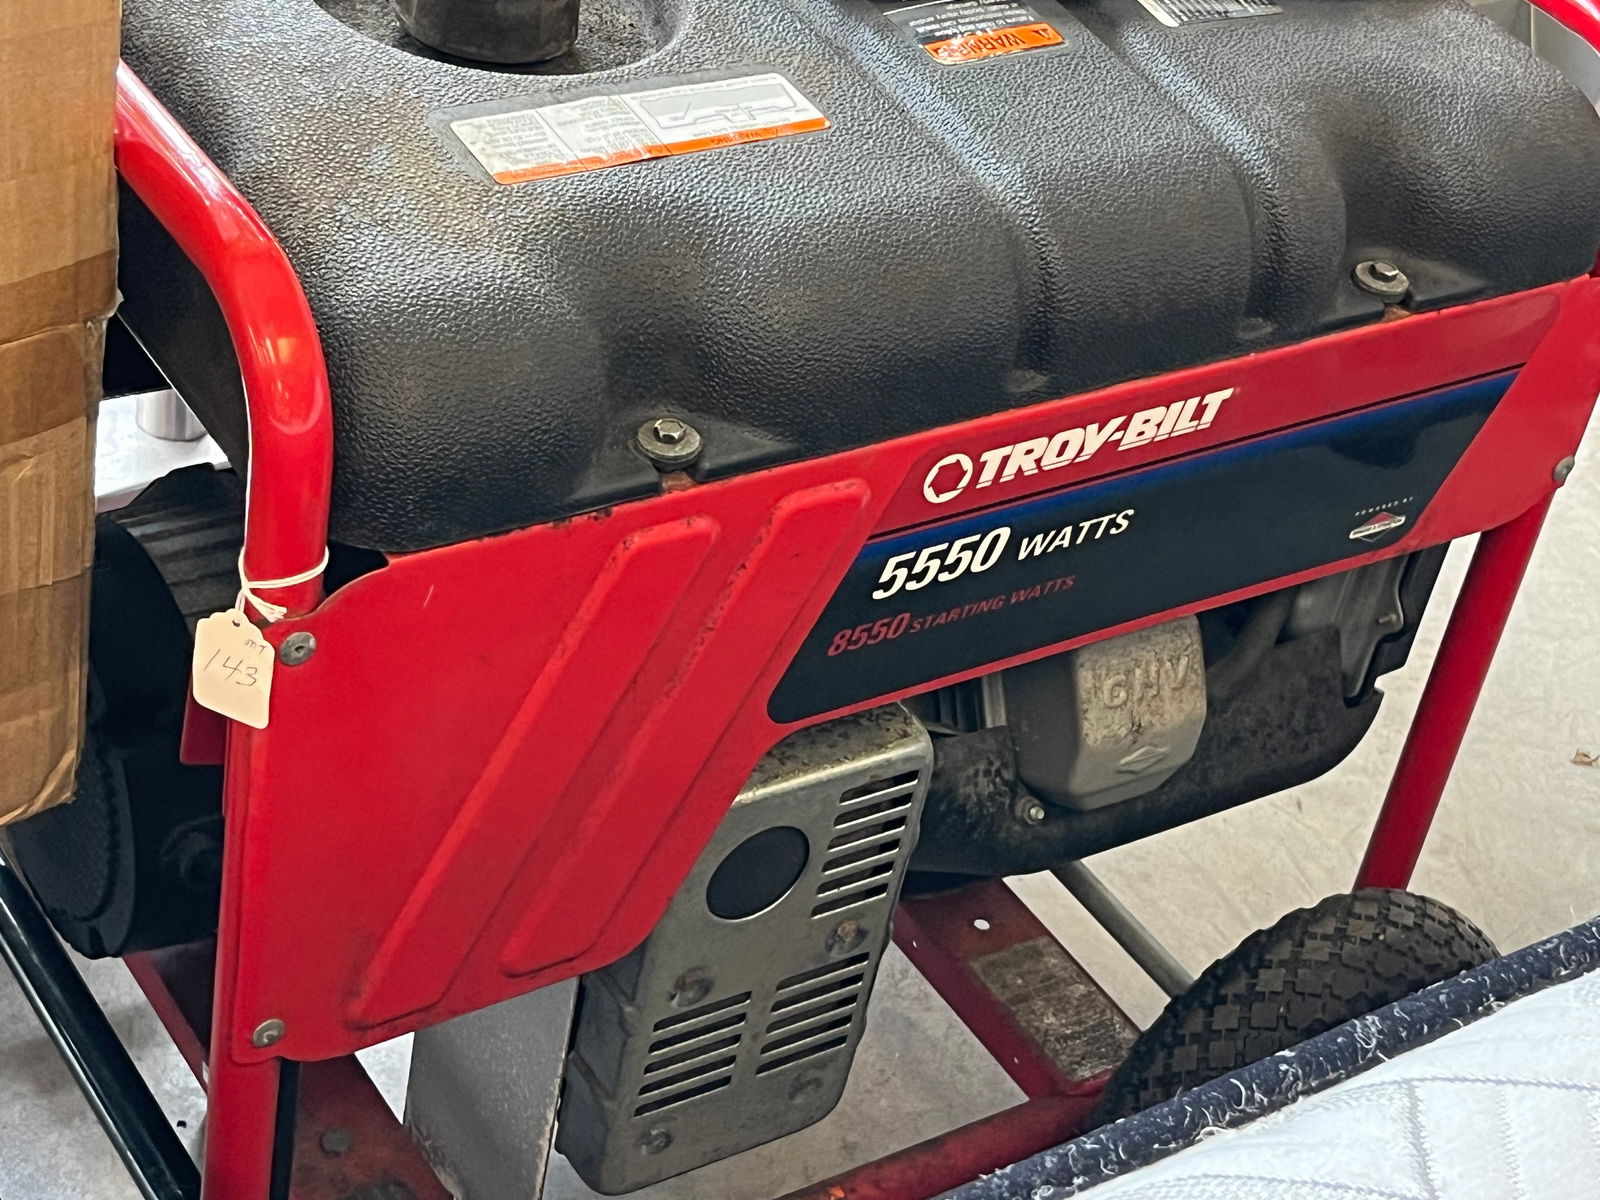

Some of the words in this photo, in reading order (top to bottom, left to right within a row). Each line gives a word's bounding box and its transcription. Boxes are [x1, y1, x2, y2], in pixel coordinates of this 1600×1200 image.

[944, 33, 1026, 57] WARNI
[975, 387, 1234, 489] TROY-BILT
[872, 526, 1012, 600] 5550
[1017, 509, 1135, 560] WATTS
[827, 612, 911, 657] 8550
[909, 594, 1005, 633] STARTING
[1009, 575, 1077, 604] WATTS
[203, 648, 258, 687] 143
